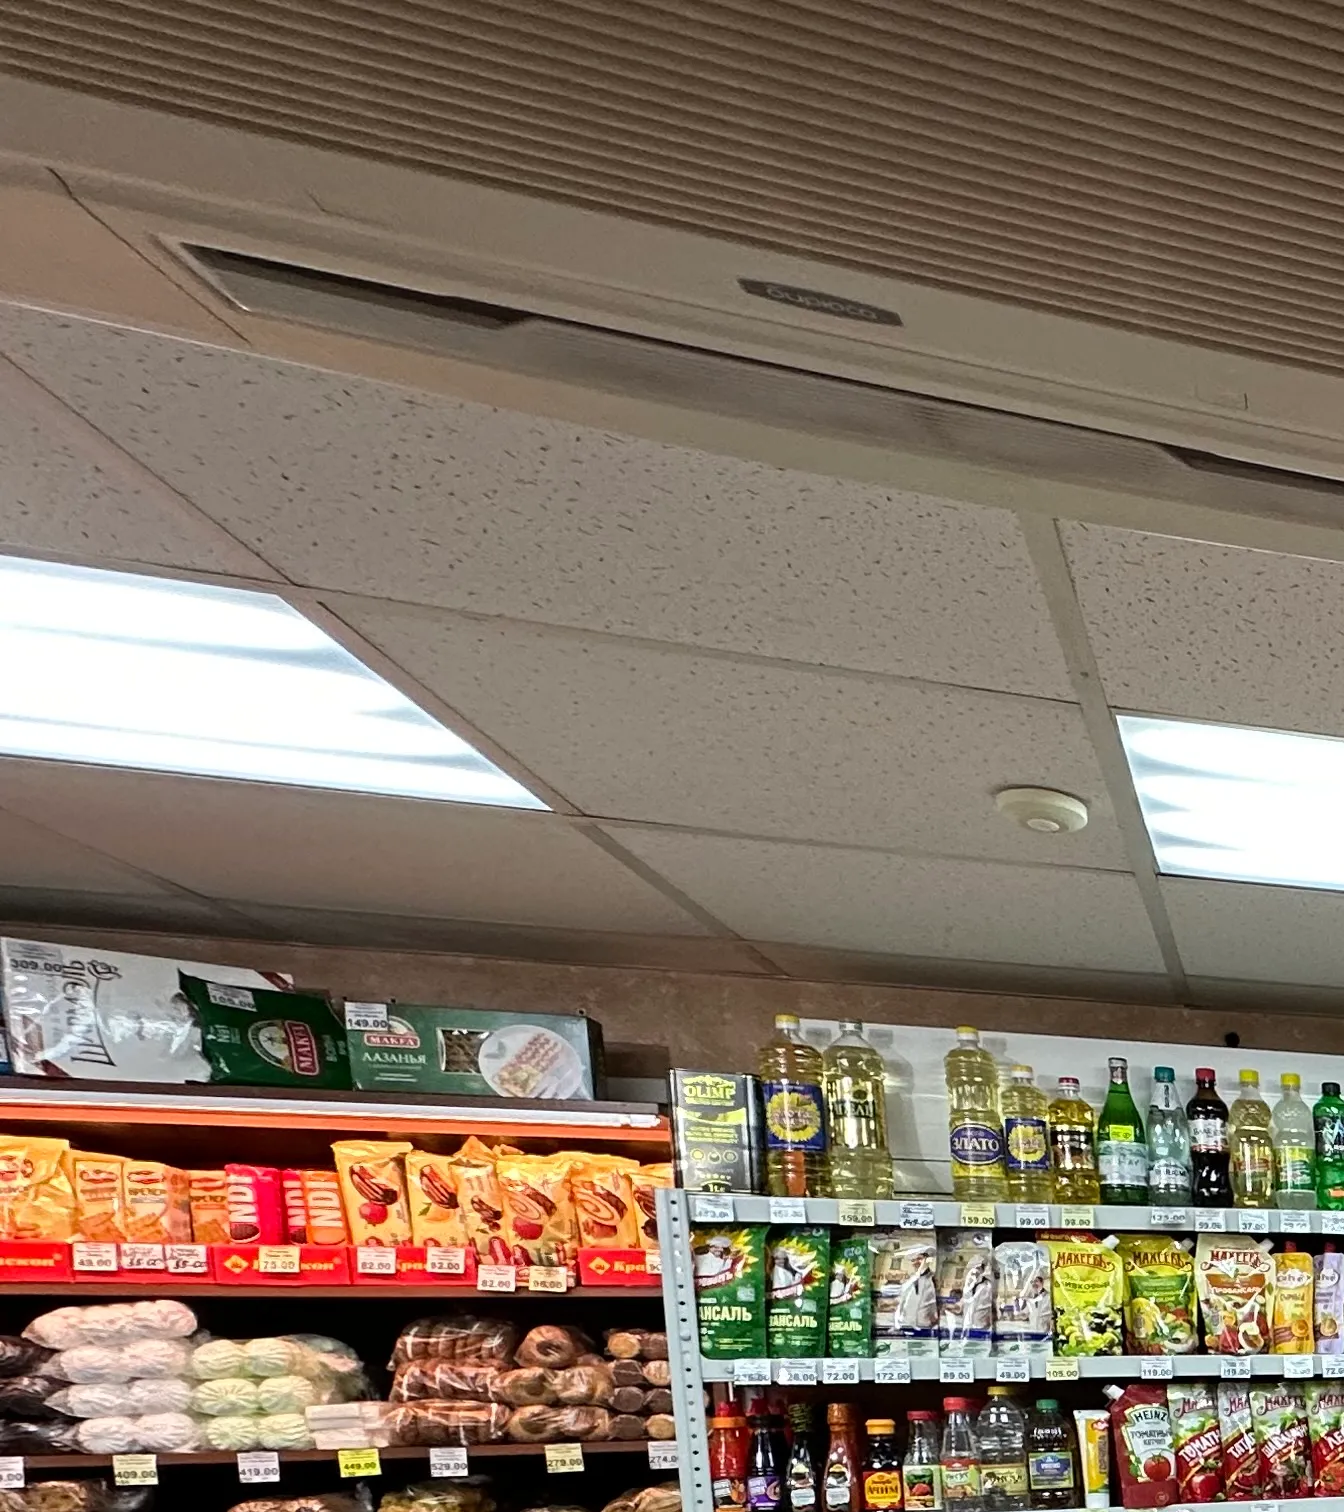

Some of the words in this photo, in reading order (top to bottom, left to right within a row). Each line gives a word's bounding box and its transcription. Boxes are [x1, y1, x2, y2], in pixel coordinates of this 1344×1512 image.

[348, 1018, 389, 1028] 149.00
[362, 1052, 426, 1064] ЛАЗАНЬЯ
[952, 1138, 999, 1152] ЗЛАТО
[1134, 1411, 1167, 1423] HEINZ
